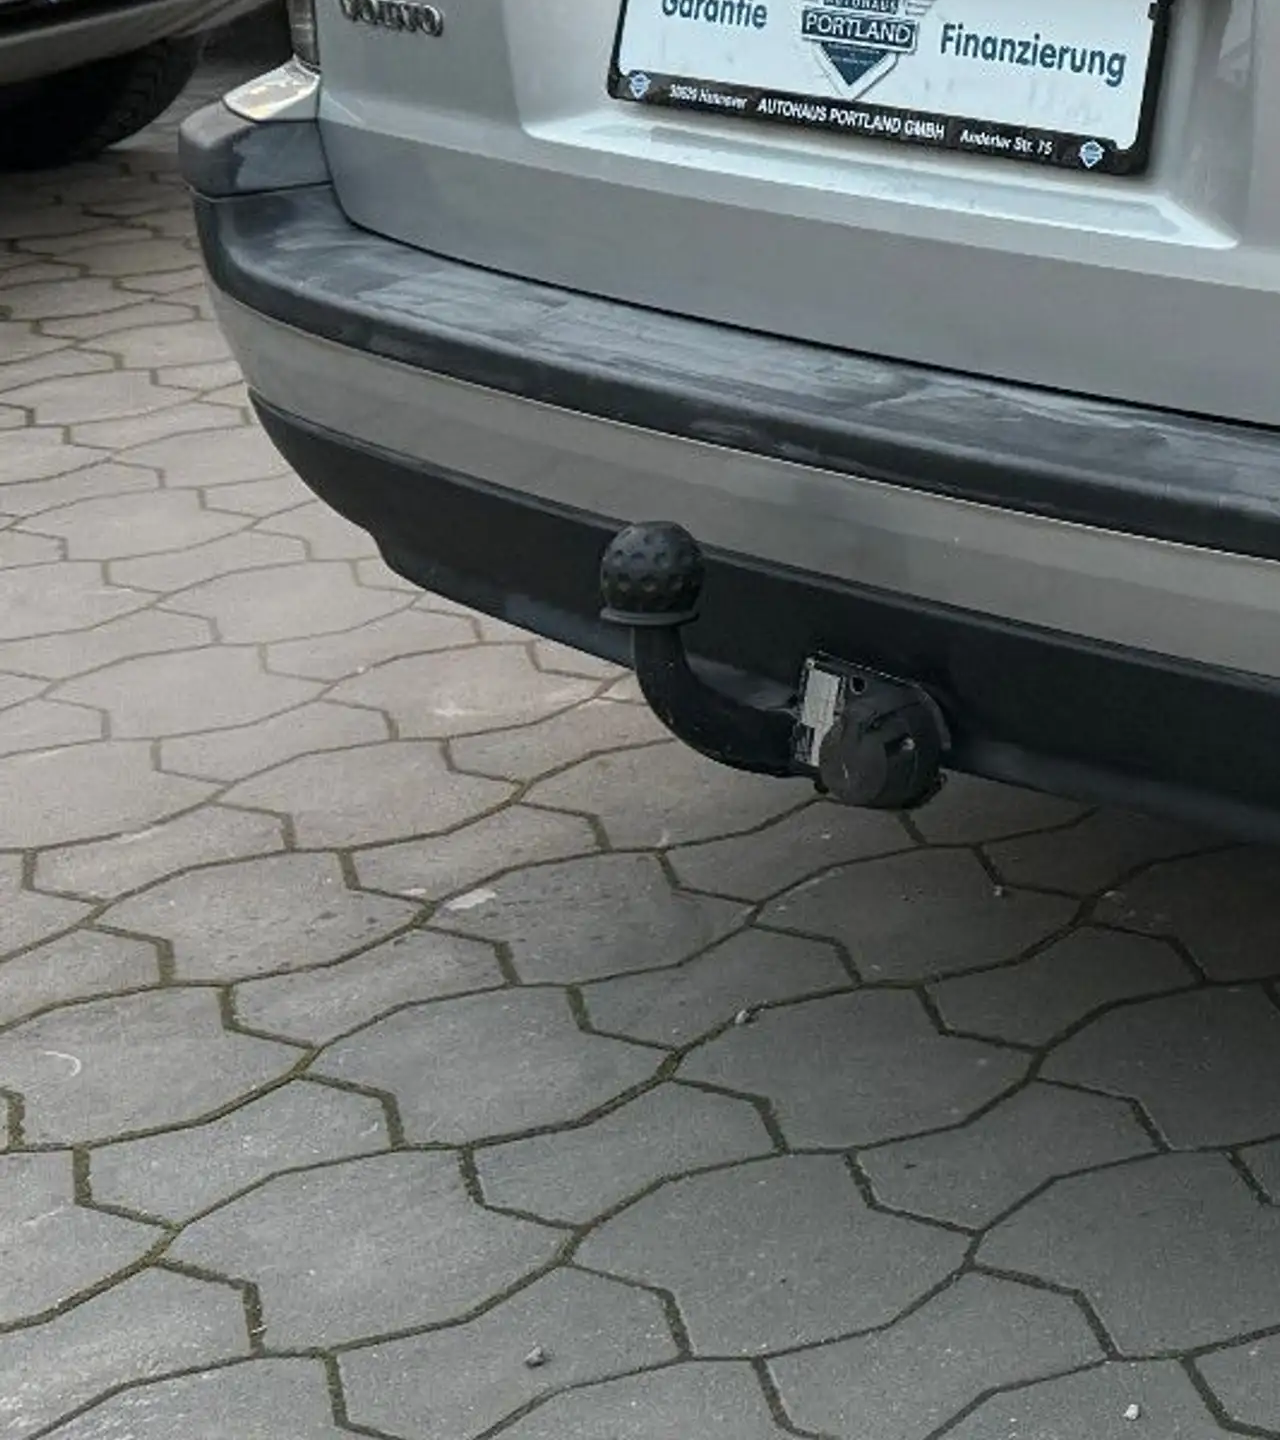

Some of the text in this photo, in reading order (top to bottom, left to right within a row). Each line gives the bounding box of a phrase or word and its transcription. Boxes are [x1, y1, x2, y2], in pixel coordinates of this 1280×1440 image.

[805, 13, 911, 44] PORTLAND
[940, 23, 1127, 87] Finanzierung
[757, 97, 828, 122] AUTOHAUS
[828, 107, 901, 134] PORTLAND
